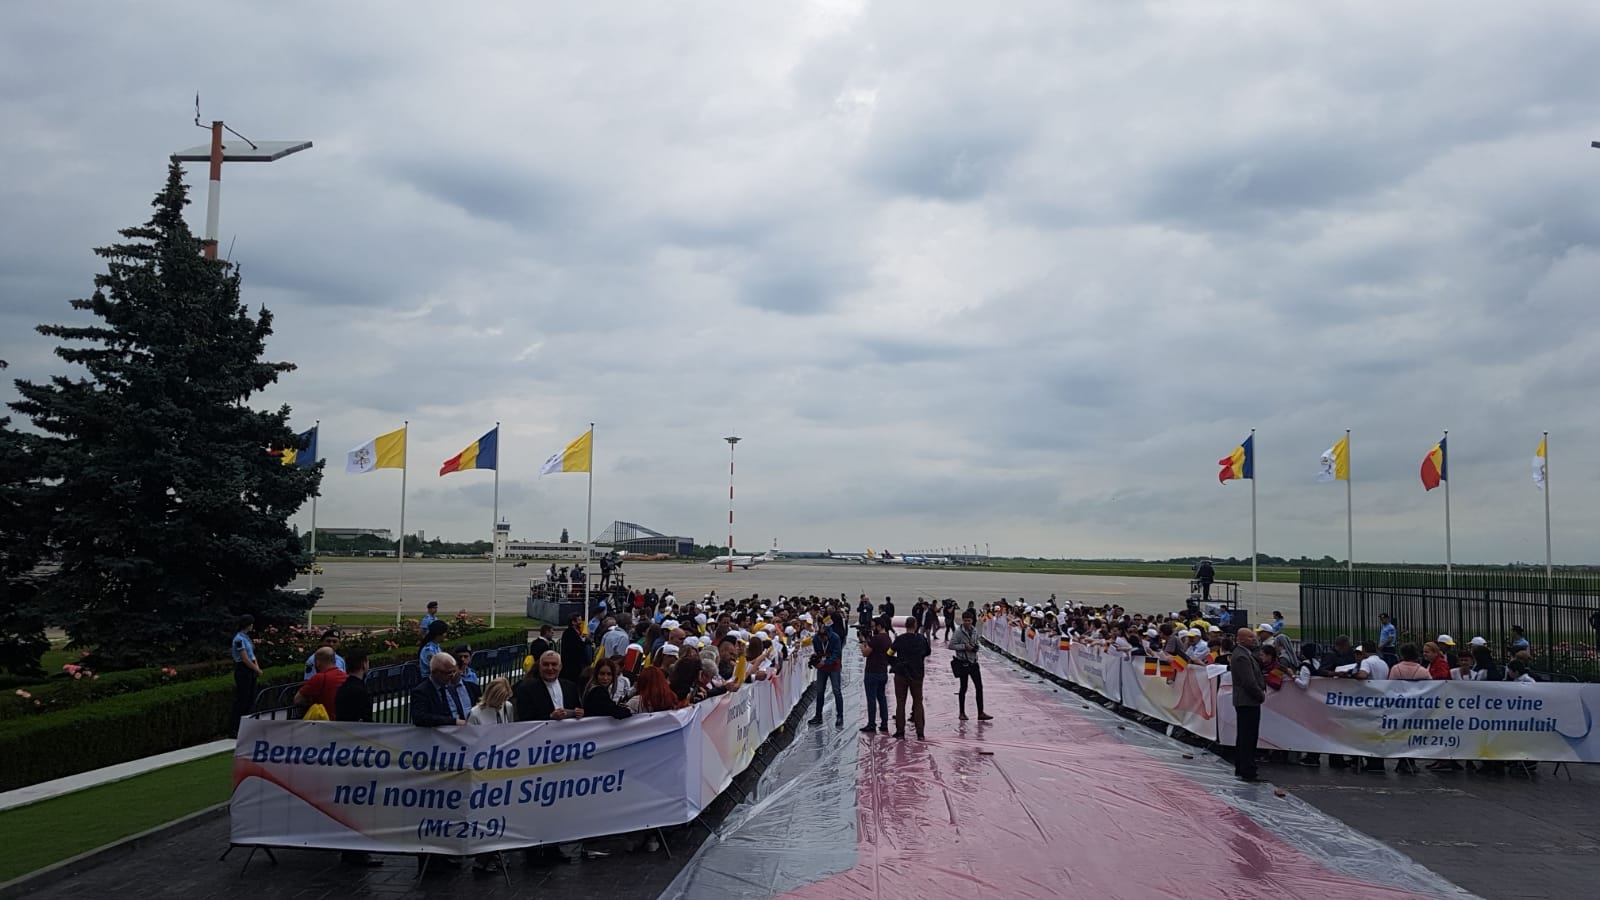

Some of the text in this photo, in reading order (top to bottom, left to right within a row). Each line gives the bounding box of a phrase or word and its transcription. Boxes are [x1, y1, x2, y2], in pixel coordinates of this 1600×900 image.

[1325, 691, 1543, 711] Binecuvântat e cel ce vine
[1381, 714, 1557, 732] în numele Domnului!
[1408, 735, 1460, 748] (Mt 21,9)
[252, 739, 597, 772] Benedetto colui che viene
[334, 769, 625, 810] nel nome del Signore!
[417, 815, 507, 840] (Mt 21,9)
